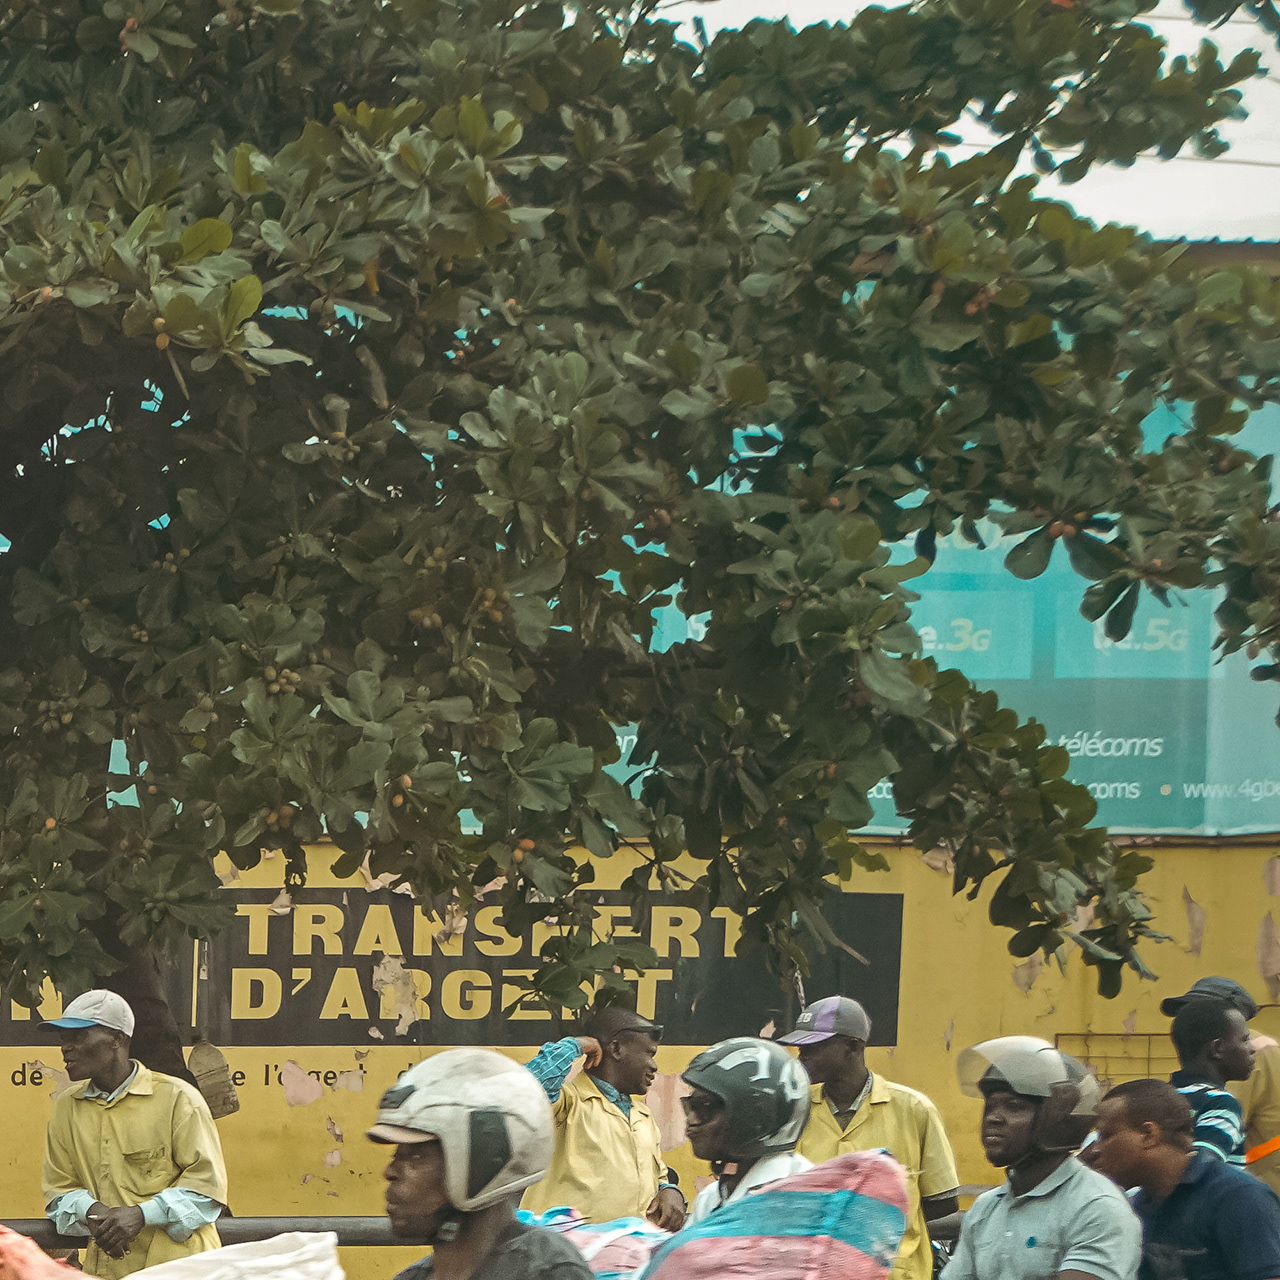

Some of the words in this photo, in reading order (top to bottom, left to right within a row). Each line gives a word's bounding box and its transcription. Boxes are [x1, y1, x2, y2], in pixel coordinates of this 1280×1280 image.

[1058, 730, 1164, 758] télécoms
[230, 966, 673, 1021] D'ARGET
[11, 1062, 44, 1087] de
[230, 1068, 246, 1087] e
